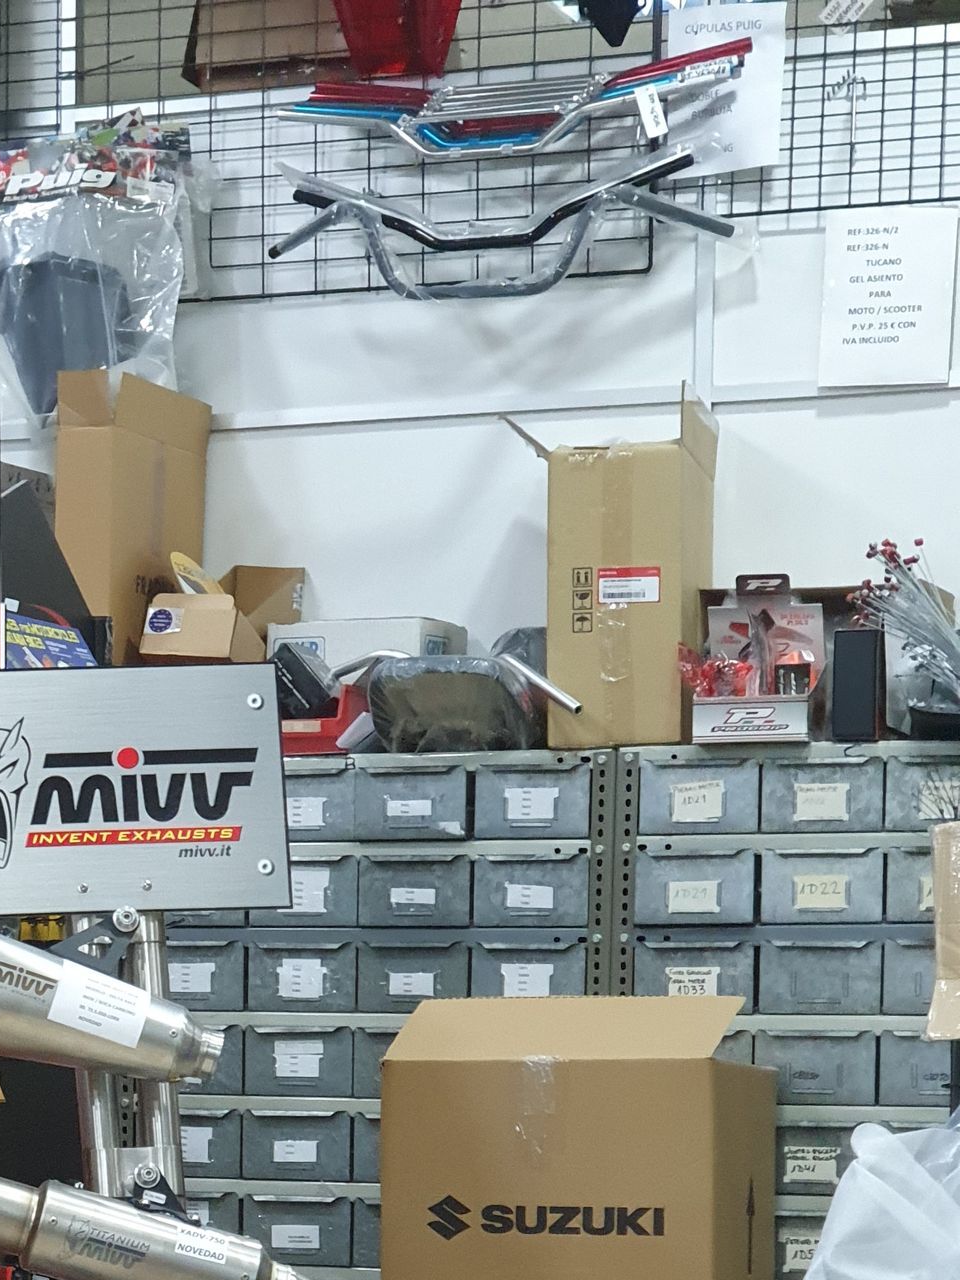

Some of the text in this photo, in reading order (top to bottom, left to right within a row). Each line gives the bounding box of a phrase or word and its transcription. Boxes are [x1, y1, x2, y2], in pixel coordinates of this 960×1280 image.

[736, 19, 762, 31] PUIG
[5, 164, 117, 196] Puig
[866, 258, 902, 267] TUCANO
[849, 274, 903, 284] GEL ASIENTO
[848, 307, 875, 315] MOTO
[883, 305, 922, 314] SCOOTER
[852, 323, 876, 331] P.V.P.
[898, 321, 916, 329] CON
[842, 335, 899, 345] IVA INCLUIDO
[32, 827, 234, 844] INVENT EXHAUSTS
[178, 845, 232, 859] mivv.it
[481, 1204, 665, 1237] SUZUKI
[91, 1227, 150, 1251] TITANIUM
[177, 1242, 225, 1261] NOVEDAD
